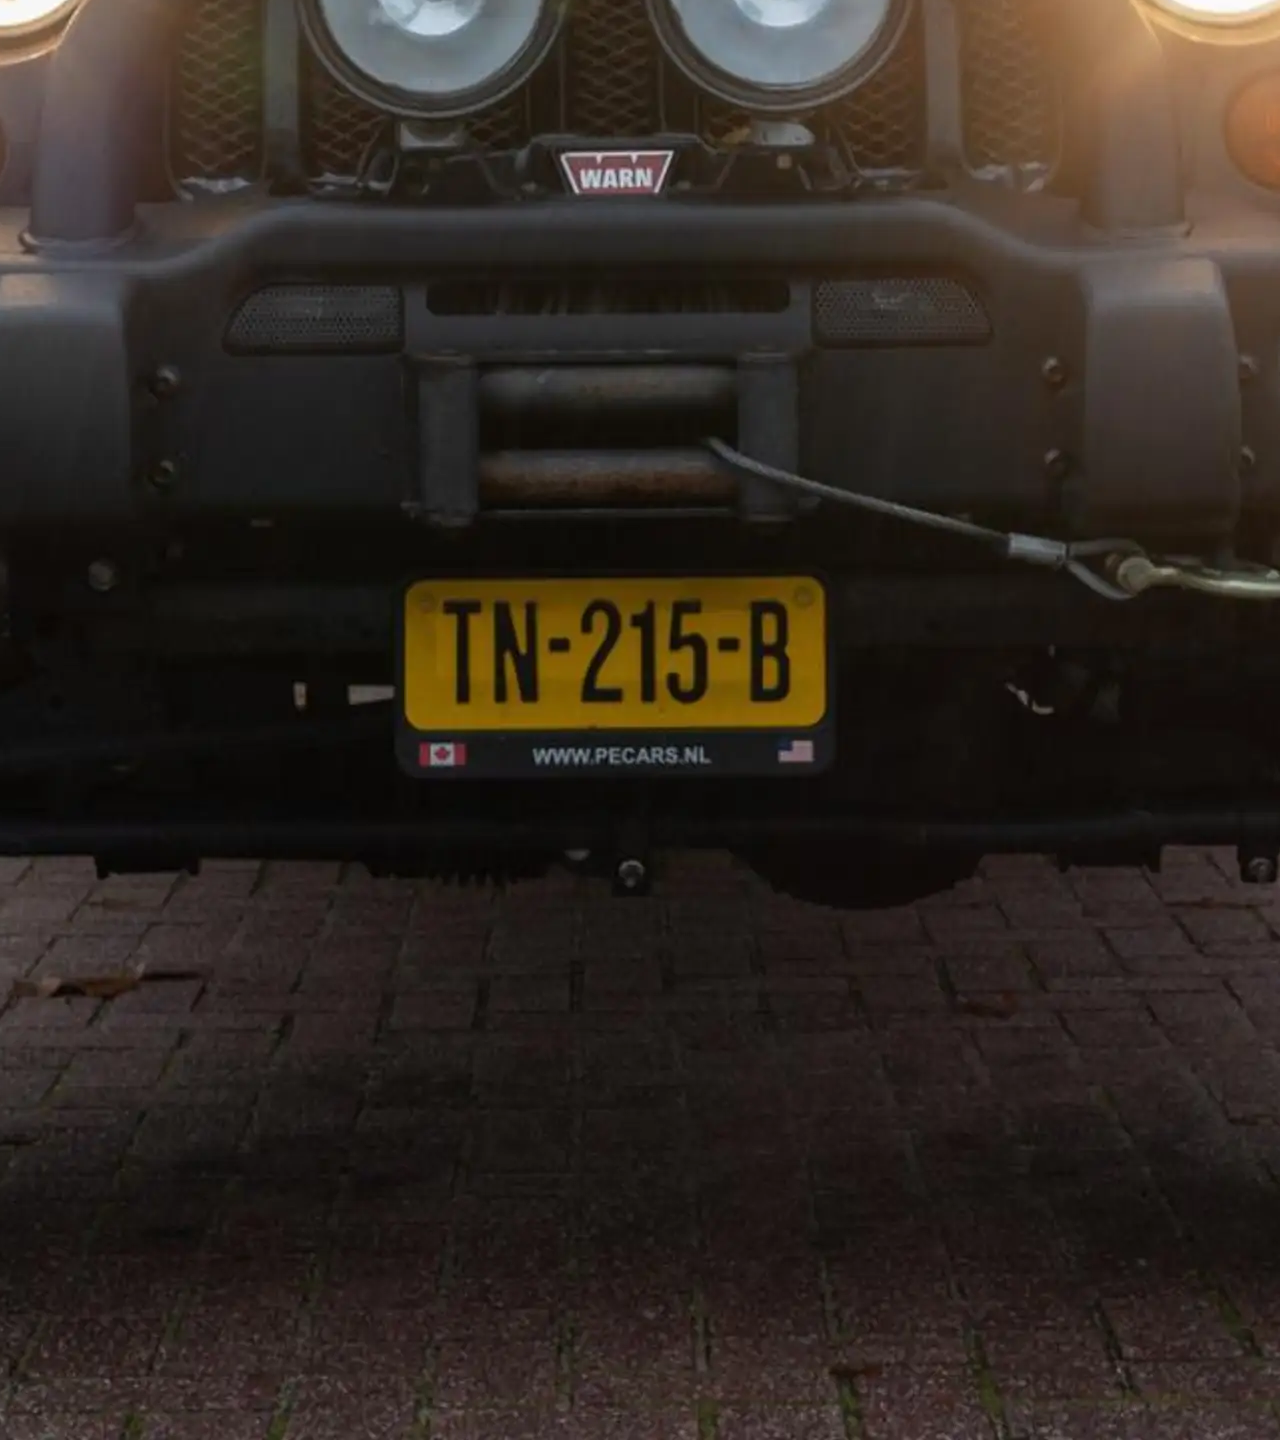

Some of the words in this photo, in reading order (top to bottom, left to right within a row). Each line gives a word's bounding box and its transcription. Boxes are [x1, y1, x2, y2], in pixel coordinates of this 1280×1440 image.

[579, 167, 654, 190] WARN
[442, 598, 791, 704] TN-215-B
[532, 745, 713, 766] WWW.PECARS.NL
